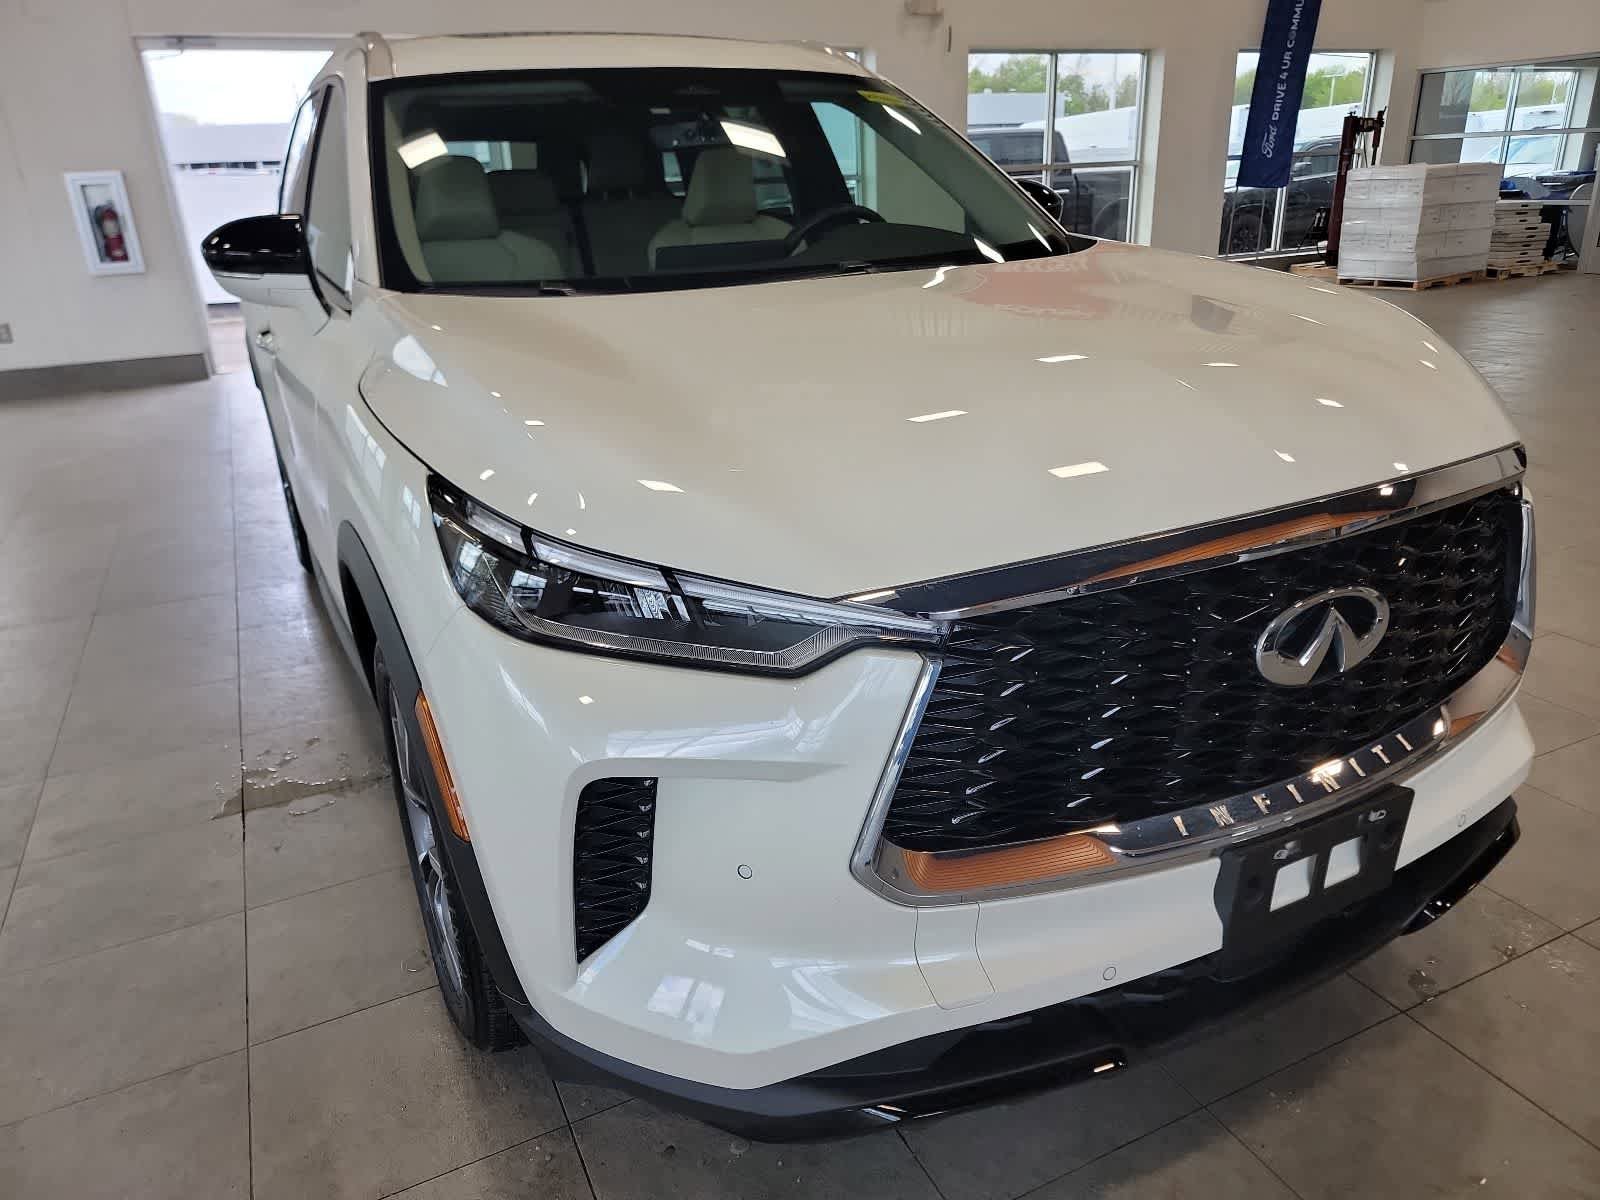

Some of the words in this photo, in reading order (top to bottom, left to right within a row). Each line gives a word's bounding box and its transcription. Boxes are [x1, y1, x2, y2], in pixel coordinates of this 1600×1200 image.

[1287, 0, 1305, 48] COMMU
[1280, 73, 1288, 83] 4
[1281, 51, 1293, 70] UR
[1271, 84, 1287, 121] DRIVE
[1262, 125, 1278, 159] Ford
[1172, 733, 1413, 837] INFINITI
